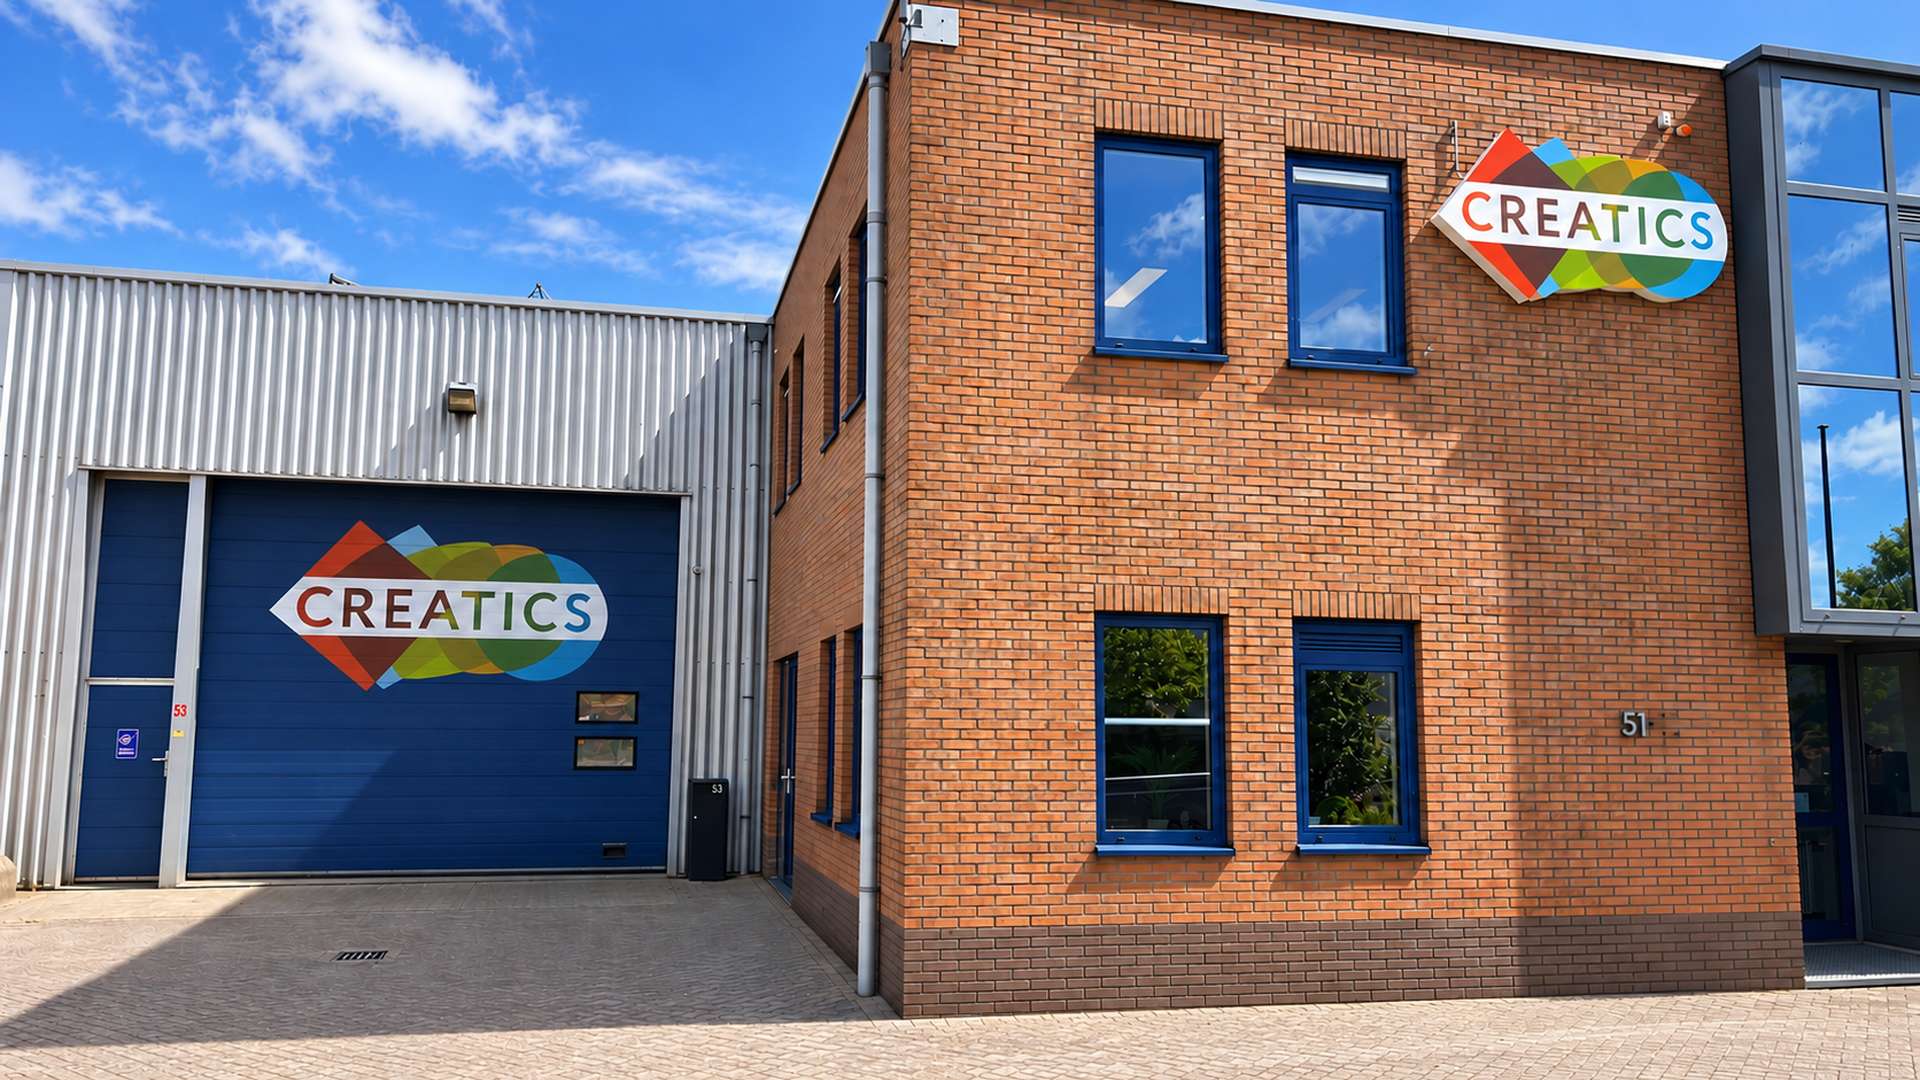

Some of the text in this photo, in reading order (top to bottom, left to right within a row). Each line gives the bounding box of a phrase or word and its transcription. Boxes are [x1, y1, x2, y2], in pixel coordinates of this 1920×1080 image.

[1461, 190, 1714, 250] CREATICS
[296, 586, 591, 633] CREATICS
[173, 703, 187, 717] 53
[1622, 711, 1647, 737] 51
